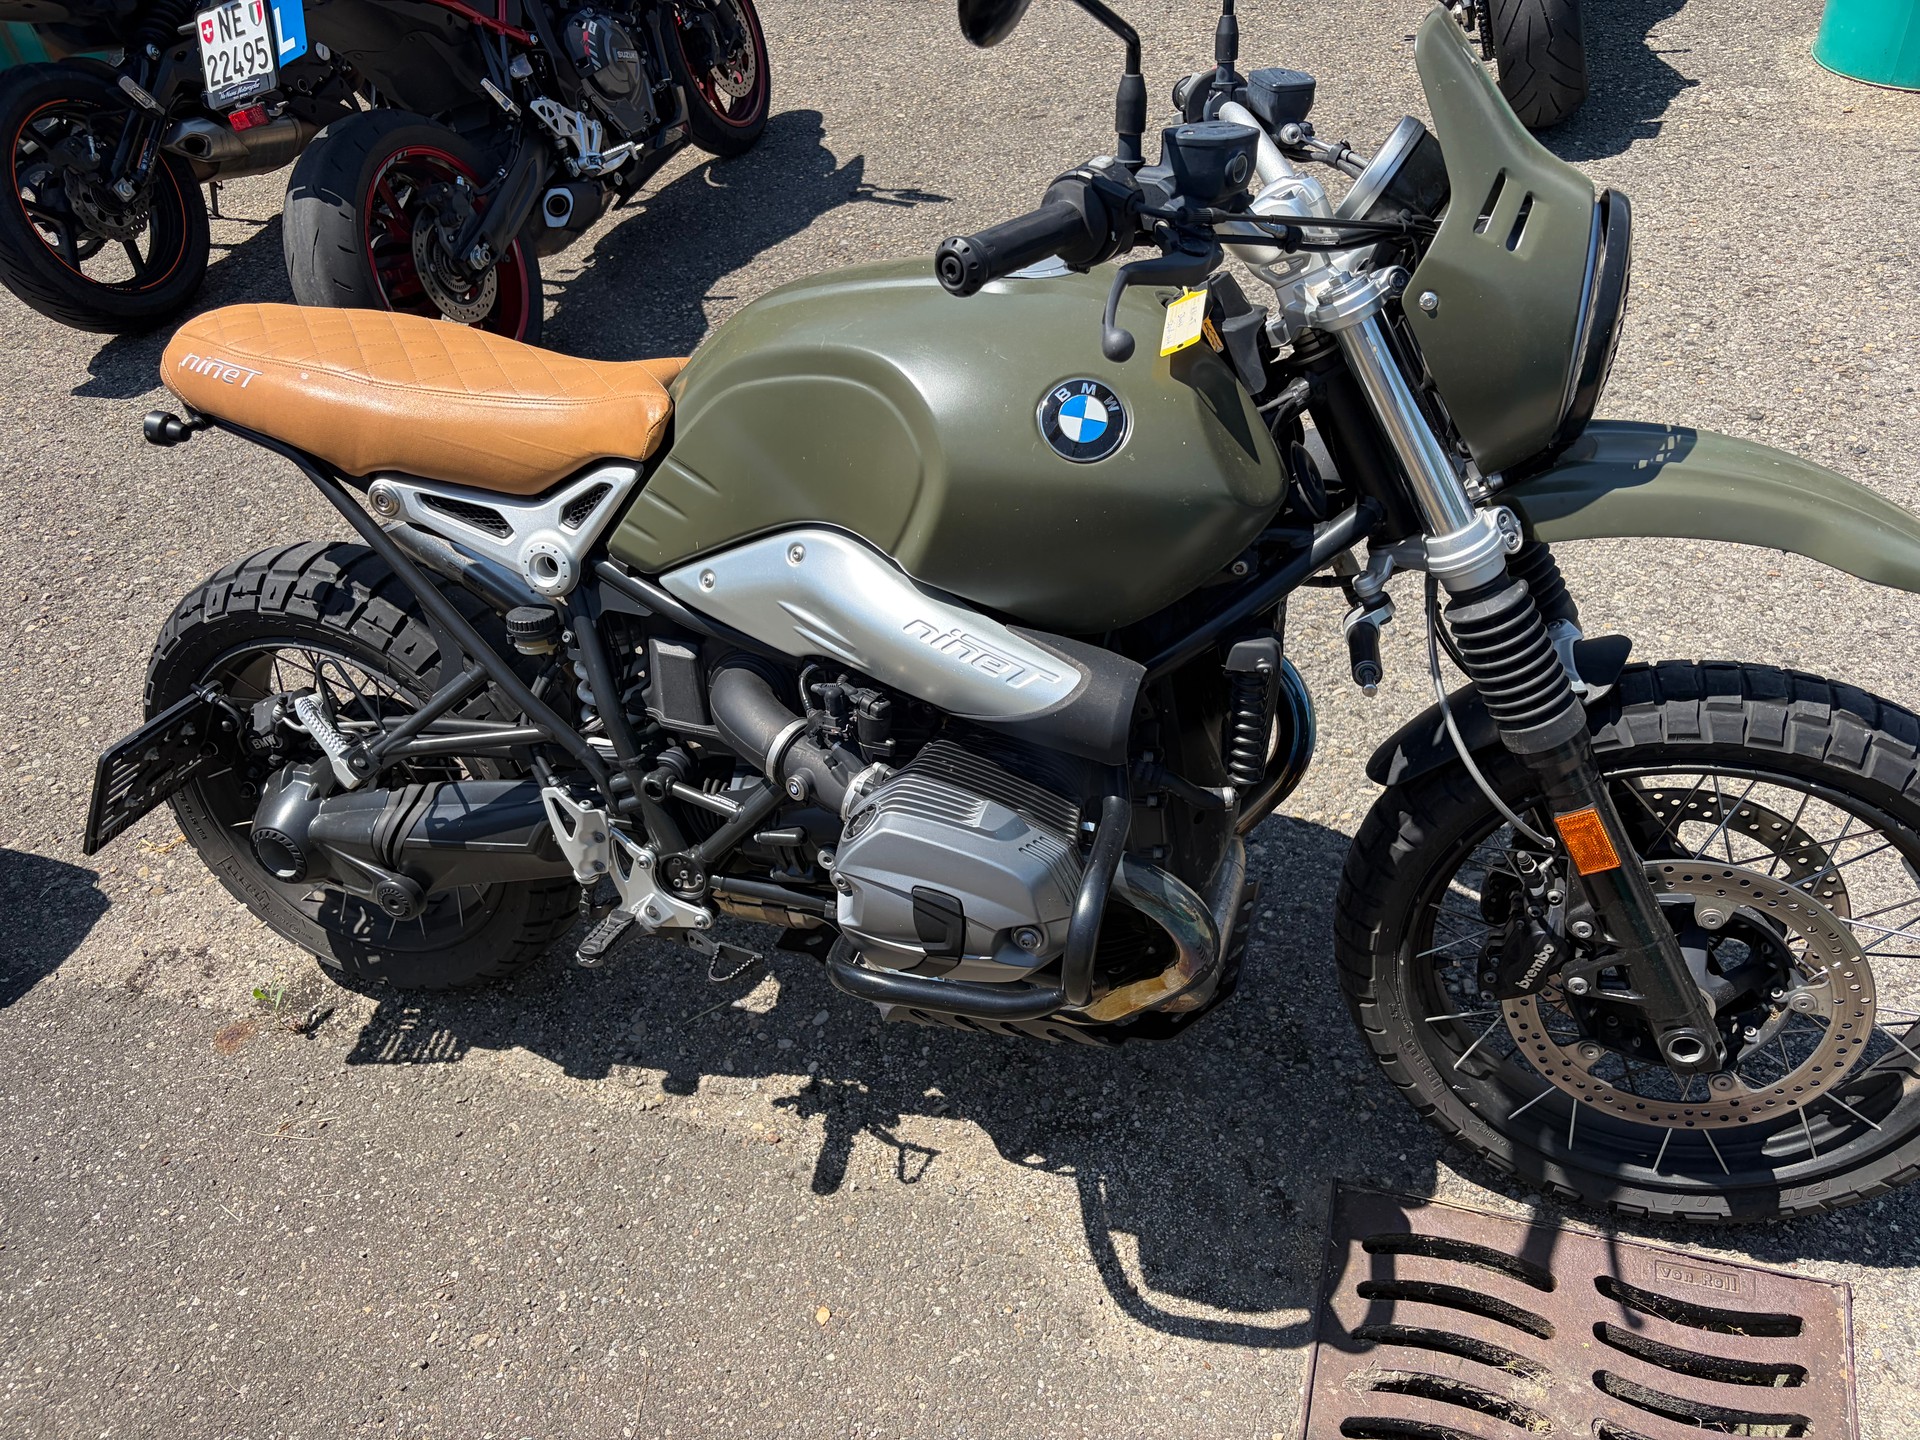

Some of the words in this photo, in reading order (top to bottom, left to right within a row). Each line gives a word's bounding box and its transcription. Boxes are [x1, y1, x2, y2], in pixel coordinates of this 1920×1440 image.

[217, 4, 246, 43] NE
[274, 7, 296, 56] L
[207, 36, 269, 88] 22495
[179, 352, 263, 388] nineT
[1055, 382, 1120, 412] BMW
[902, 618, 1062, 690] nineT
[252, 734, 277, 750] BMW
[1515, 943, 1555, 990] brembo
[1660, 1267, 1694, 1283] von
[1702, 1271, 1737, 1292] Roll
